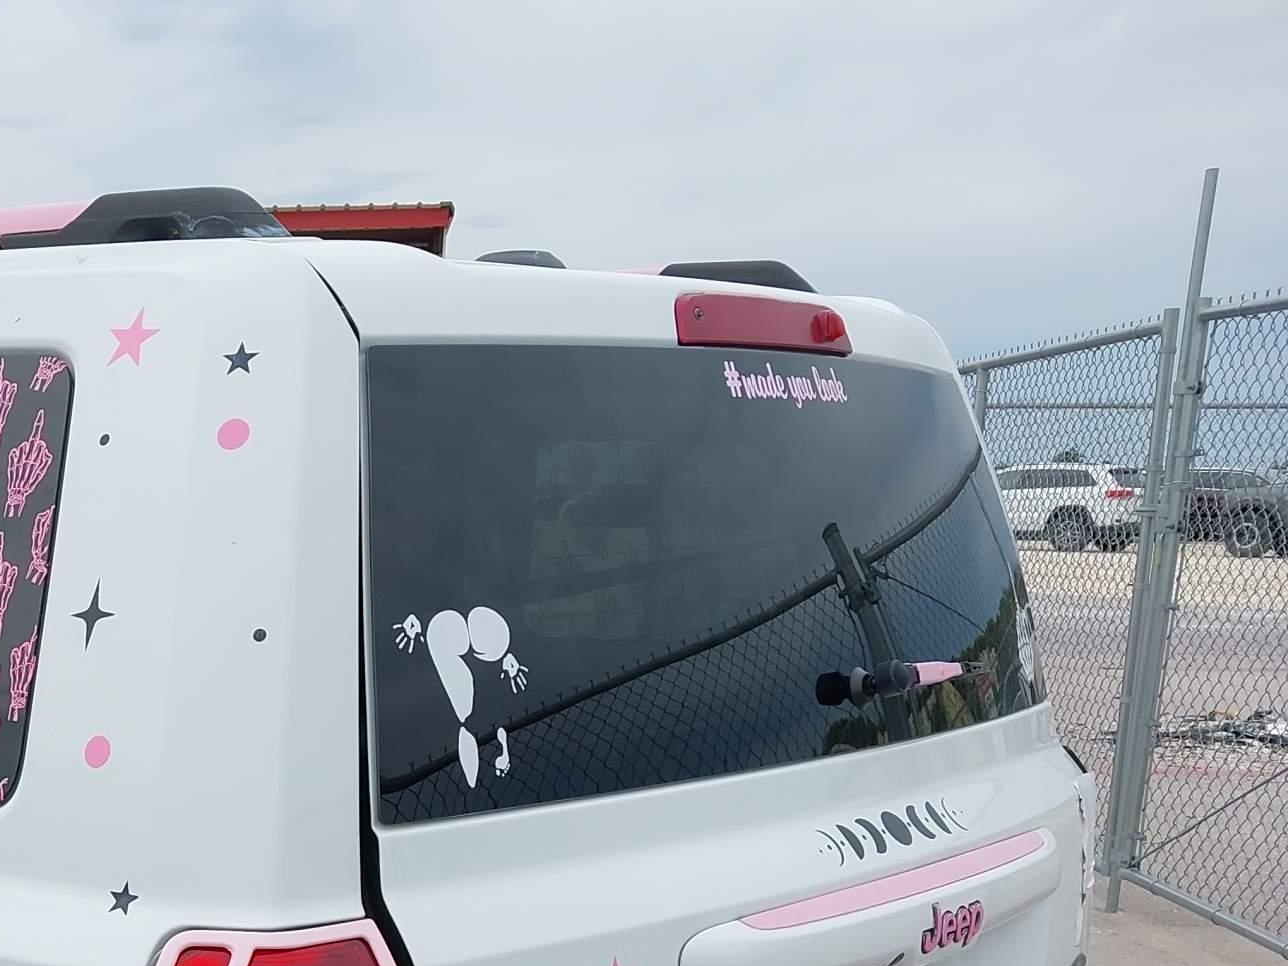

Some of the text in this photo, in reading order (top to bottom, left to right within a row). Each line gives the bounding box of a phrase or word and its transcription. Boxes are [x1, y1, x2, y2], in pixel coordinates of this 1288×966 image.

[723, 361, 848, 409] #made you look
[921, 899, 985, 954] Jeep
